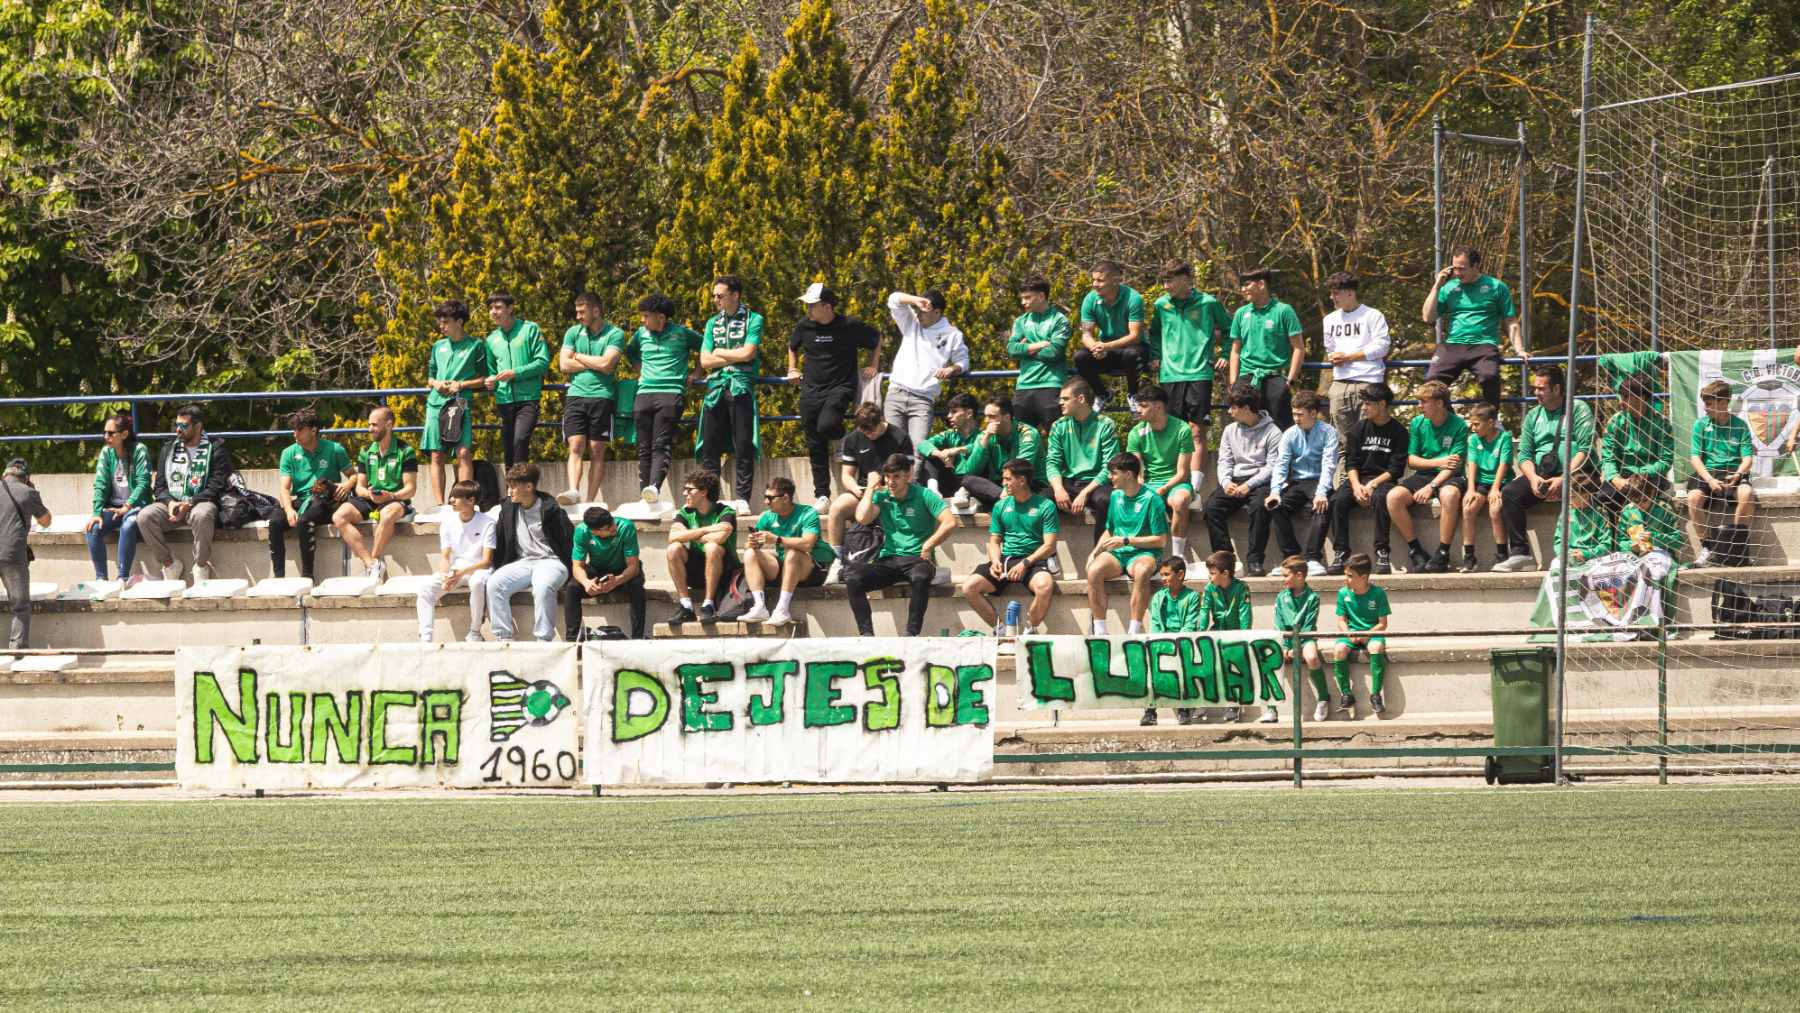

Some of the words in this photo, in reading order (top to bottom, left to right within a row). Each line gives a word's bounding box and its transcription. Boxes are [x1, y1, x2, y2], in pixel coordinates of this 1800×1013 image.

[1330, 322, 1361, 337] ICON
[1766, 362, 1800, 383] VICTOR
[193, 668, 463, 768] NUNCA
[612, 656, 905, 743] DEJES
[925, 663, 993, 729] DE
[1025, 636, 1285, 705] LUCHAR
[480, 745, 577, 783] 1960
